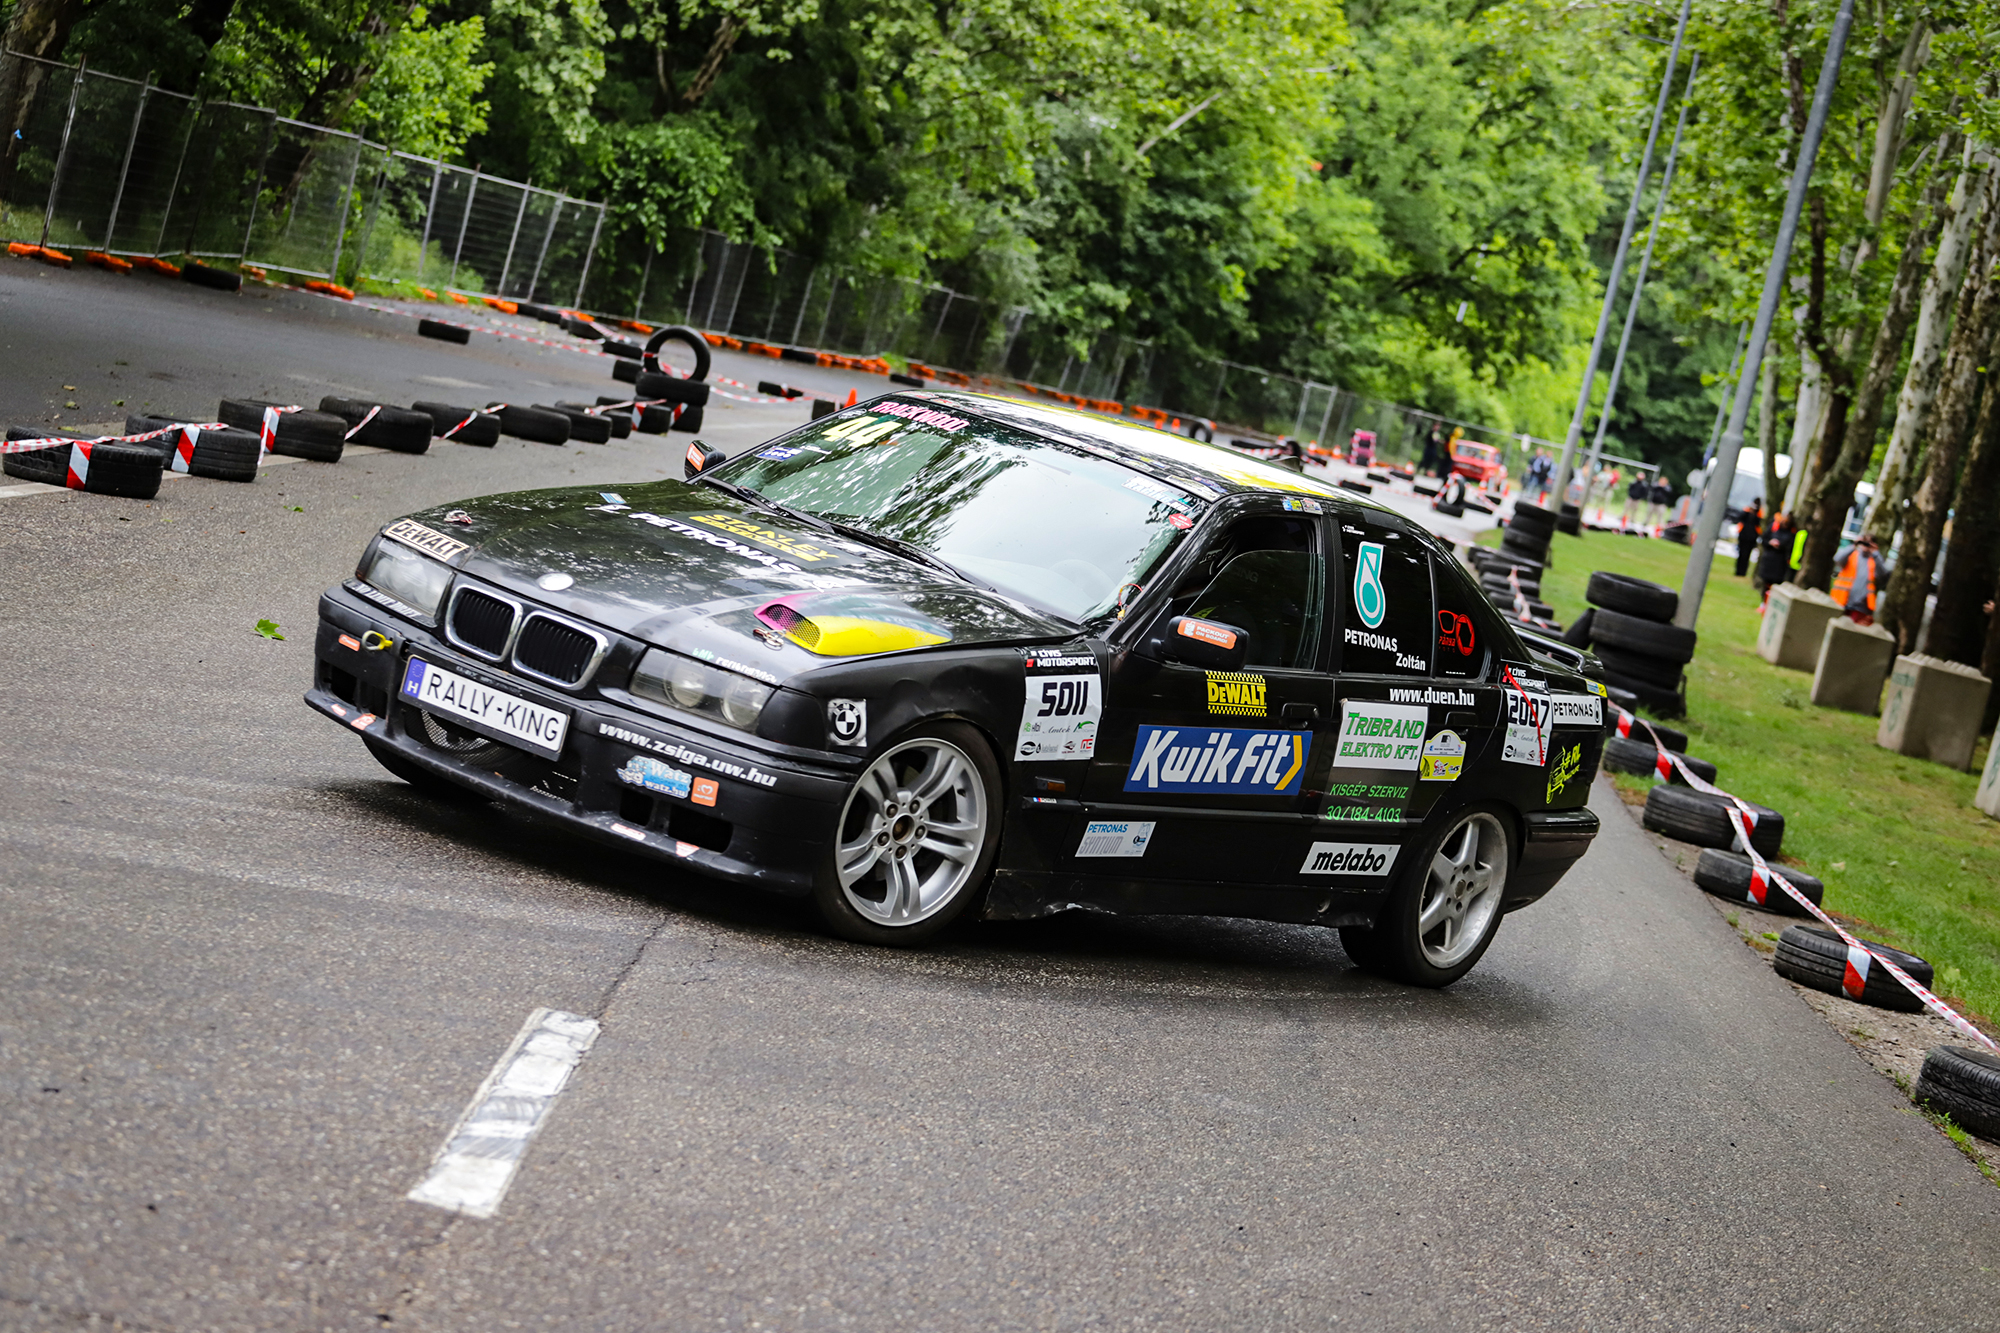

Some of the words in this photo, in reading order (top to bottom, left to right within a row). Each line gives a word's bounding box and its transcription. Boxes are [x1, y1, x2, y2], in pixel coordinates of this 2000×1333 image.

[822, 416, 903, 449] 44
[628, 512, 801, 573] PETRONAS
[1344, 628, 1398, 652] PETRONAS
[1396, 653, 1426, 671] Zoltán
[406, 680, 419, 694] H
[427, 673, 560, 742] RALLY-KING
[1037, 681, 1089, 716] 5011
[1389, 687, 1475, 706] www.duen.hu
[1508, 694, 1550, 728] 2007
[1554, 702, 1594, 717] PETRONAS
[1346, 712, 1425, 739] TRIBRAND
[598, 723, 778, 787] www.zsiga.uw.hu
[1339, 742, 1392, 758] ELEKTRO
[1394, 745, 1418, 760] KFT.
[651, 760, 690, 783] Watz
[645, 780, 686, 797] watz.hu
[1330, 781, 1367, 796] KISGÉP
[1368, 785, 1409, 798] SZERVIZ
[1325, 805, 1402, 823] 30/184-4103
[1087, 824, 1128, 833] PETRONAS
[1311, 848, 1386, 872] metabo
